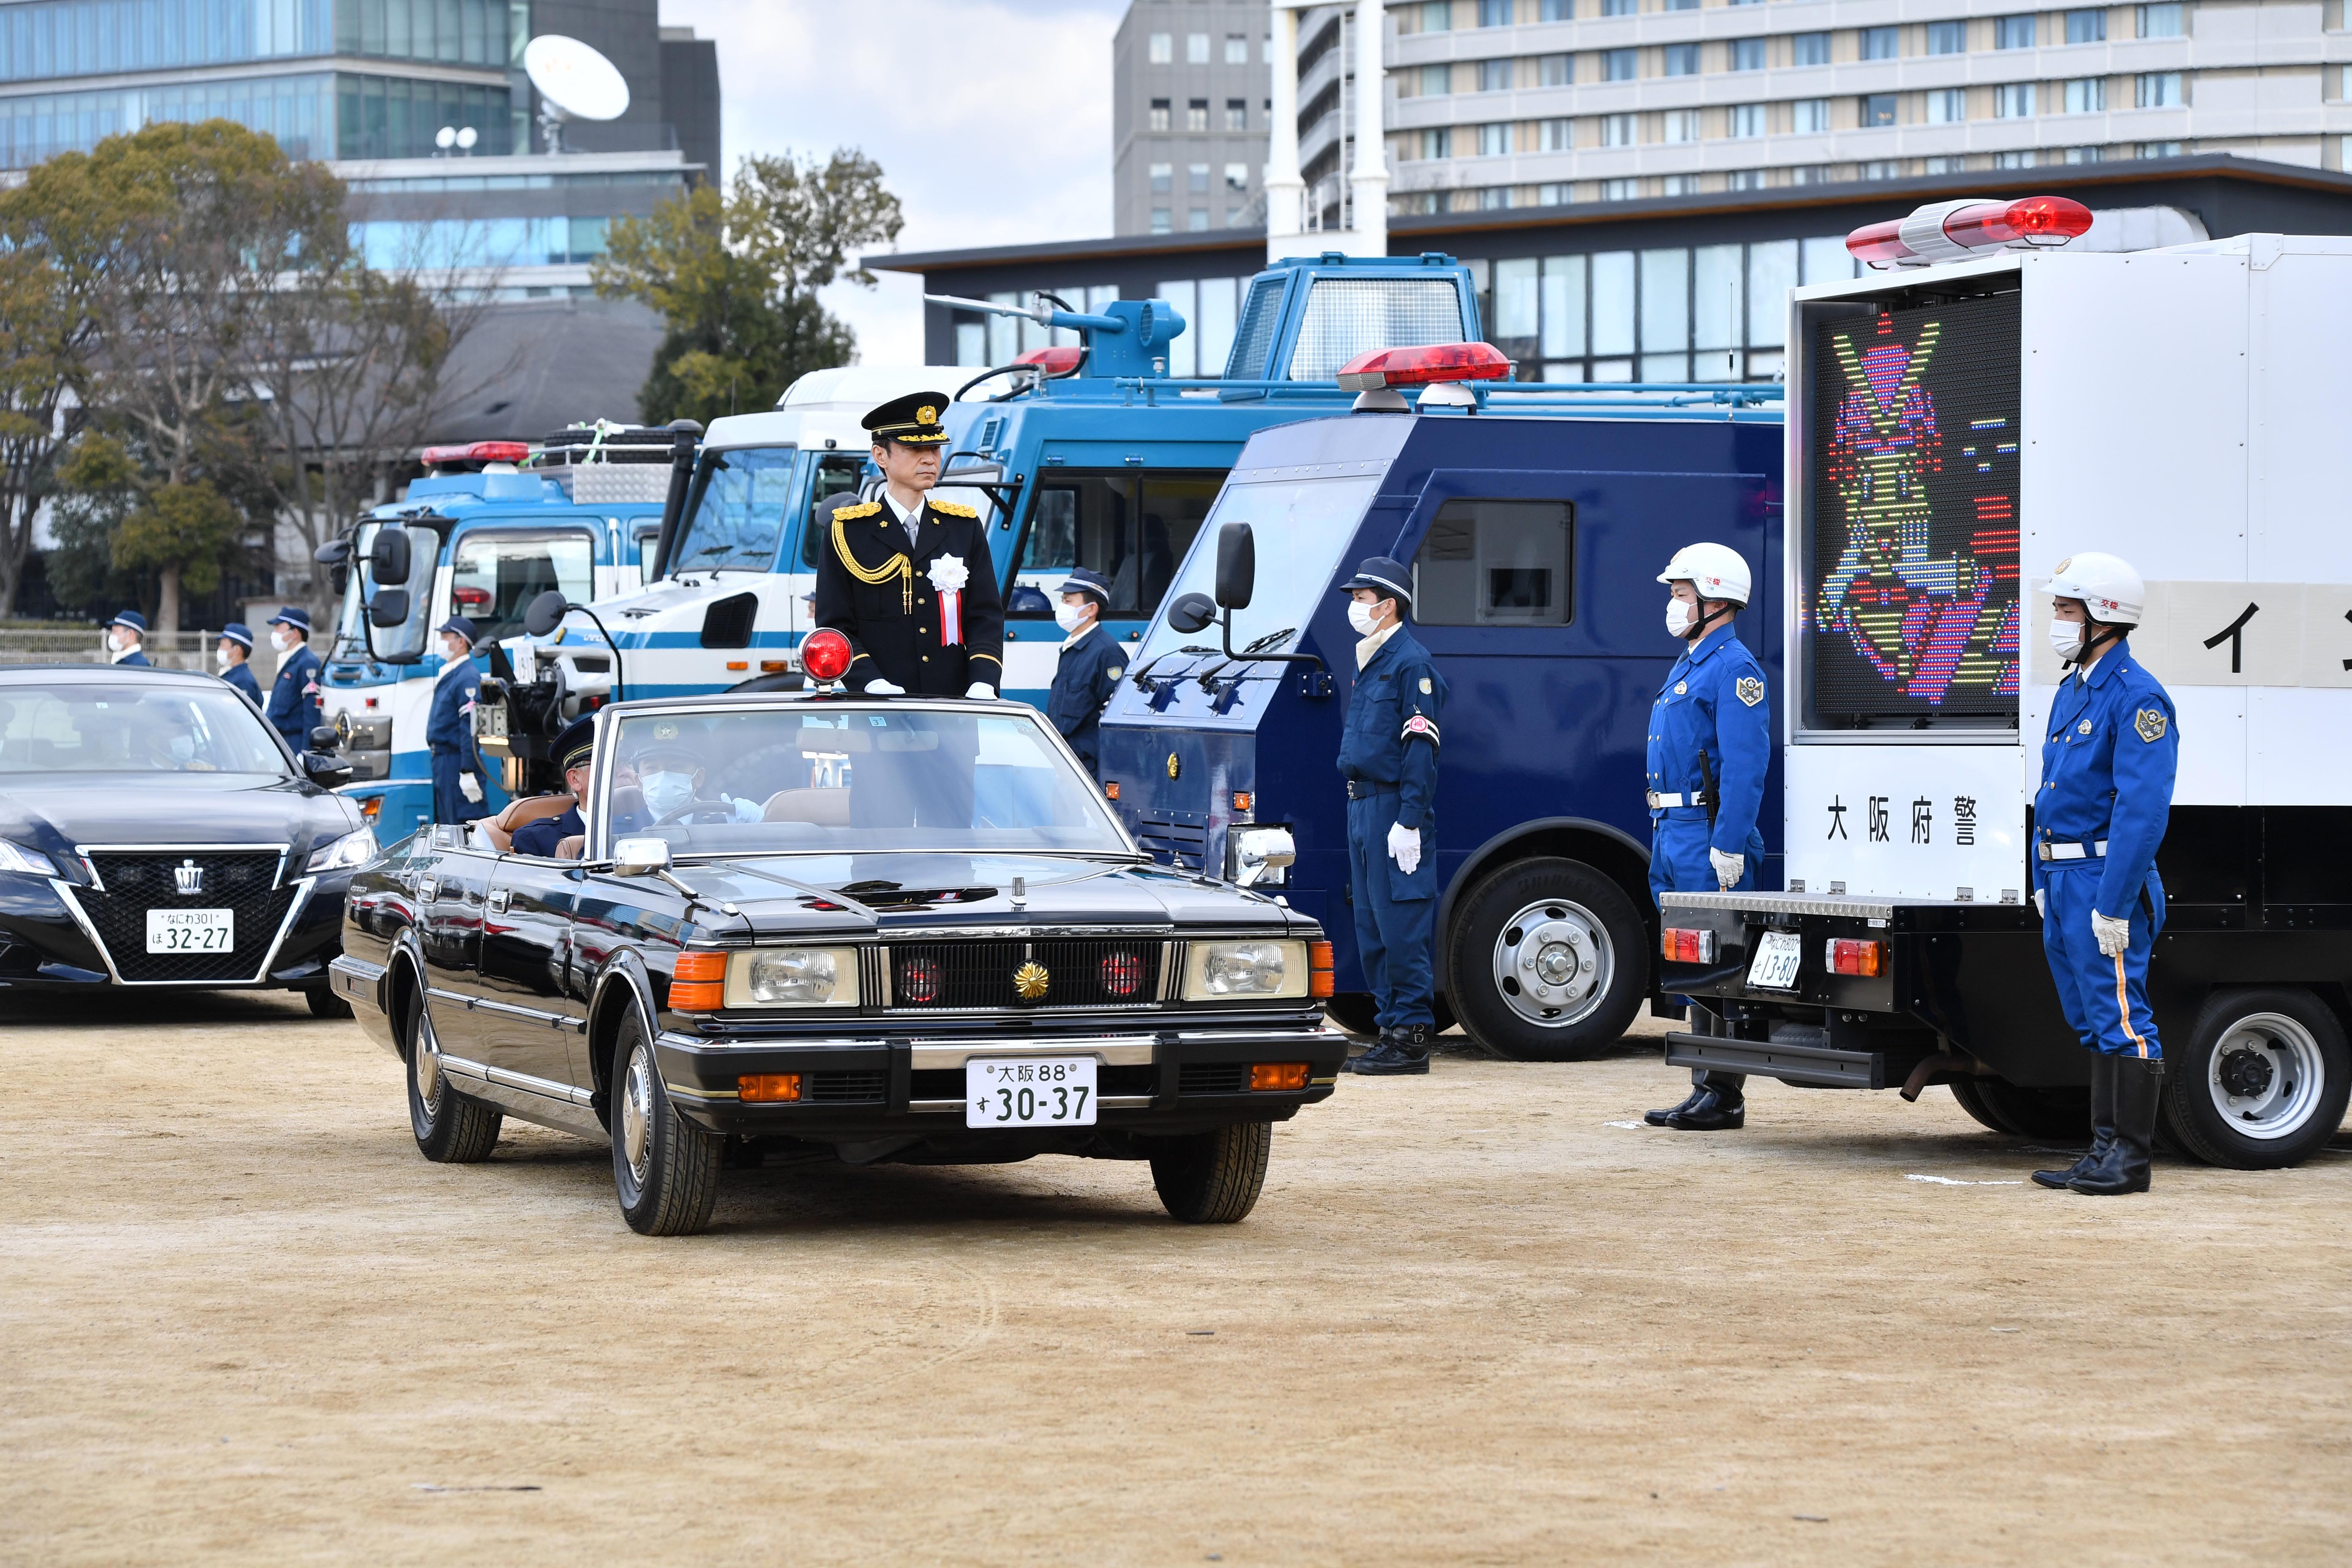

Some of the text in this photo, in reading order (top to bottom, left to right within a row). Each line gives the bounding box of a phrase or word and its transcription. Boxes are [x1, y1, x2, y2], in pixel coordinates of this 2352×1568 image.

[2101, 599, 2118, 610] 交機
[1828, 794, 1976, 845] 大阪府警
[152, 928, 228, 949] ほ 32-27
[1754, 954, 1797, 982] せ 13-80
[976, 1086, 1089, 1122] す 30-37
